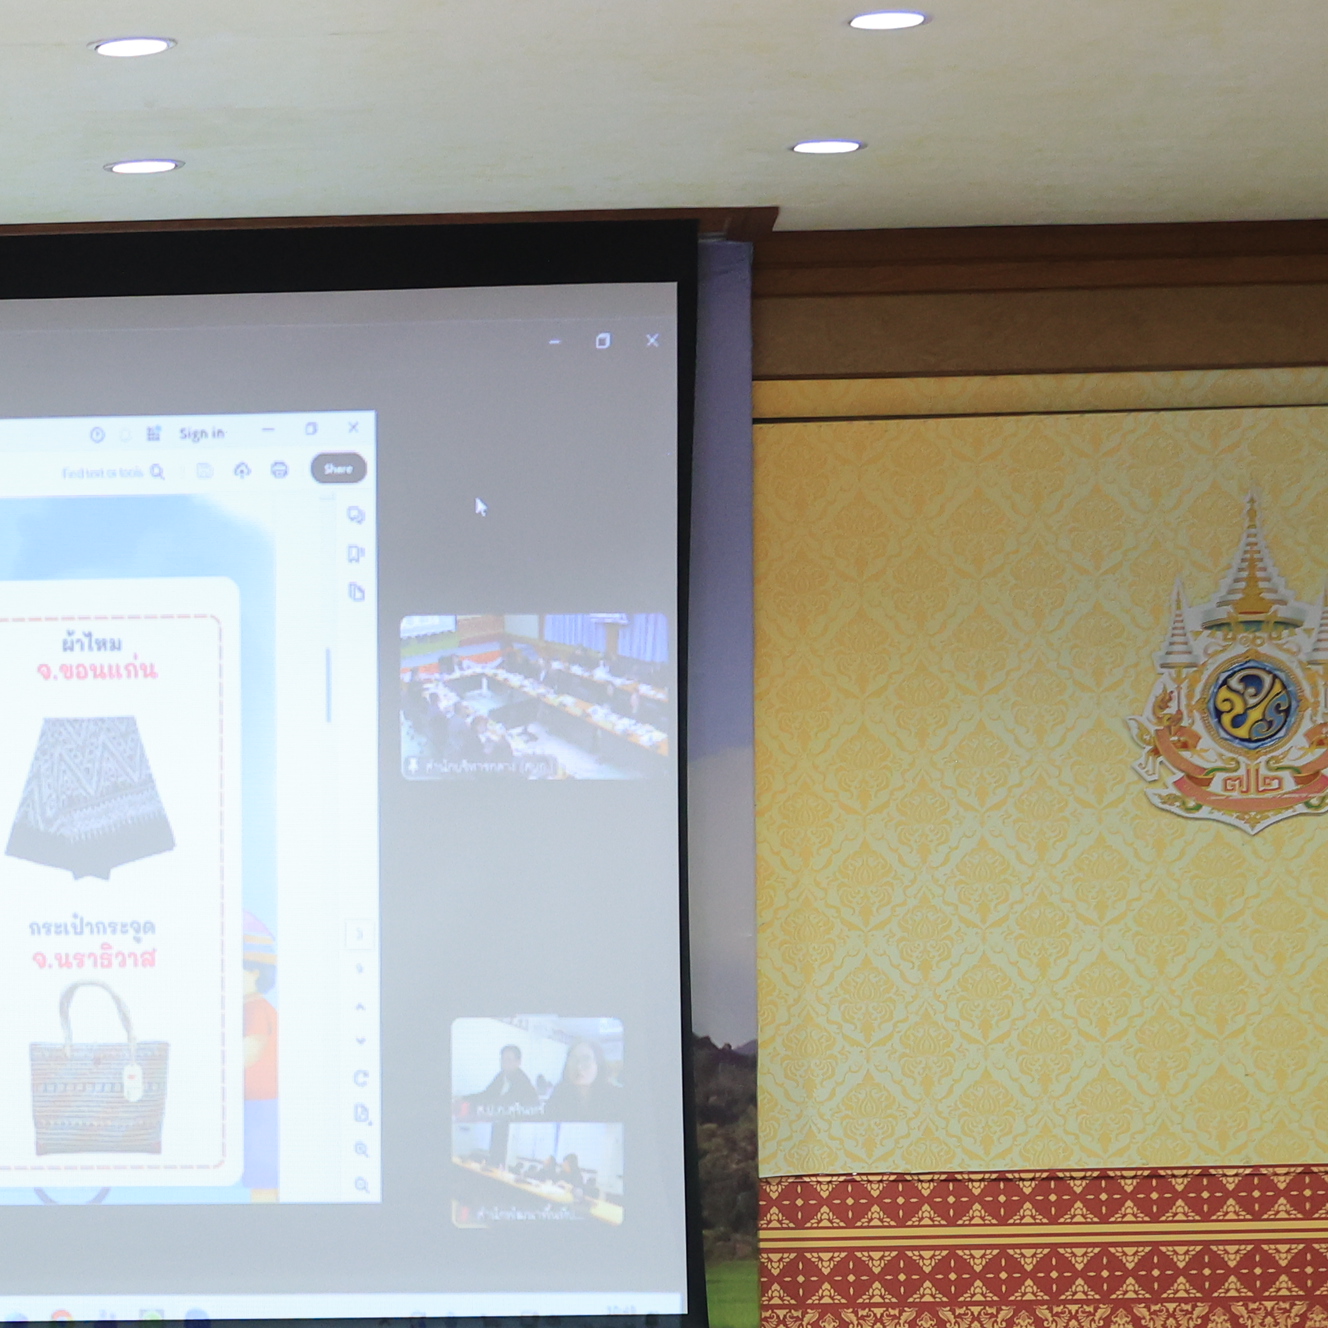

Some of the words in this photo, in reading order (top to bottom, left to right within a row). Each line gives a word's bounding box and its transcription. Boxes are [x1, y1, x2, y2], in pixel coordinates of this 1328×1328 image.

[180, 427, 209, 443] Sign
[212, 427, 225, 440] in
[323, 462, 354, 475] Share
[61, 630, 123, 653] ผ้าไหม
[36, 653, 158, 682] จ.ขอนแก่น
[28, 912, 157, 943] กระเป๋ากระจูด
[31, 941, 157, 970] จ.นราธิวาส
